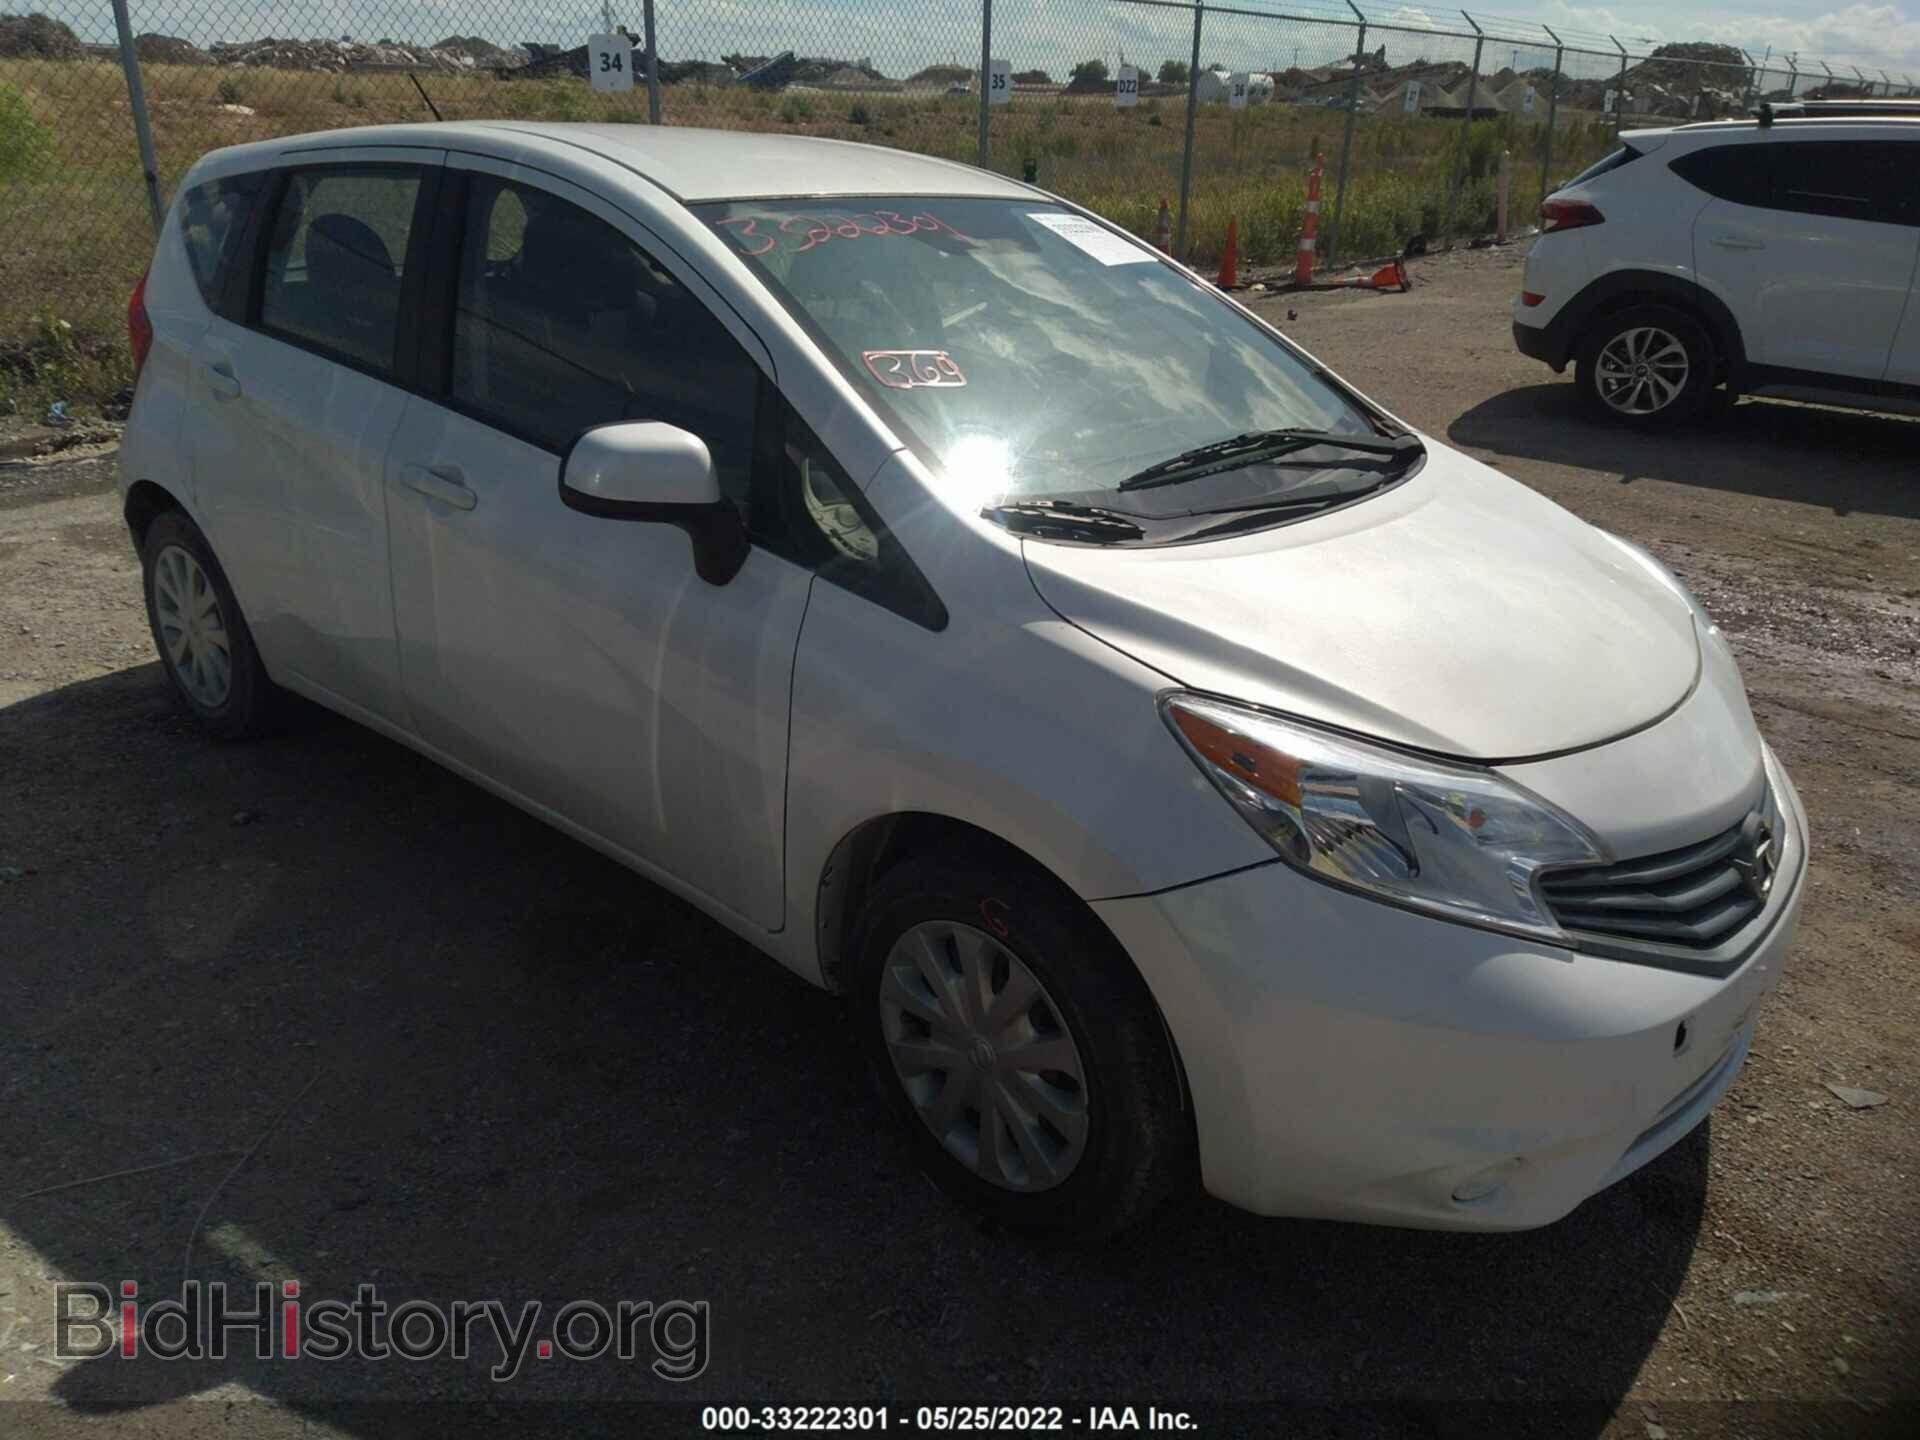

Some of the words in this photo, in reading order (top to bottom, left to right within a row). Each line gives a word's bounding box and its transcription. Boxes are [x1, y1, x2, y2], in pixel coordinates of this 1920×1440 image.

[599, 52, 623, 72] 34
[992, 74, 1006, 89] 35
[1119, 79, 1137, 93] D22
